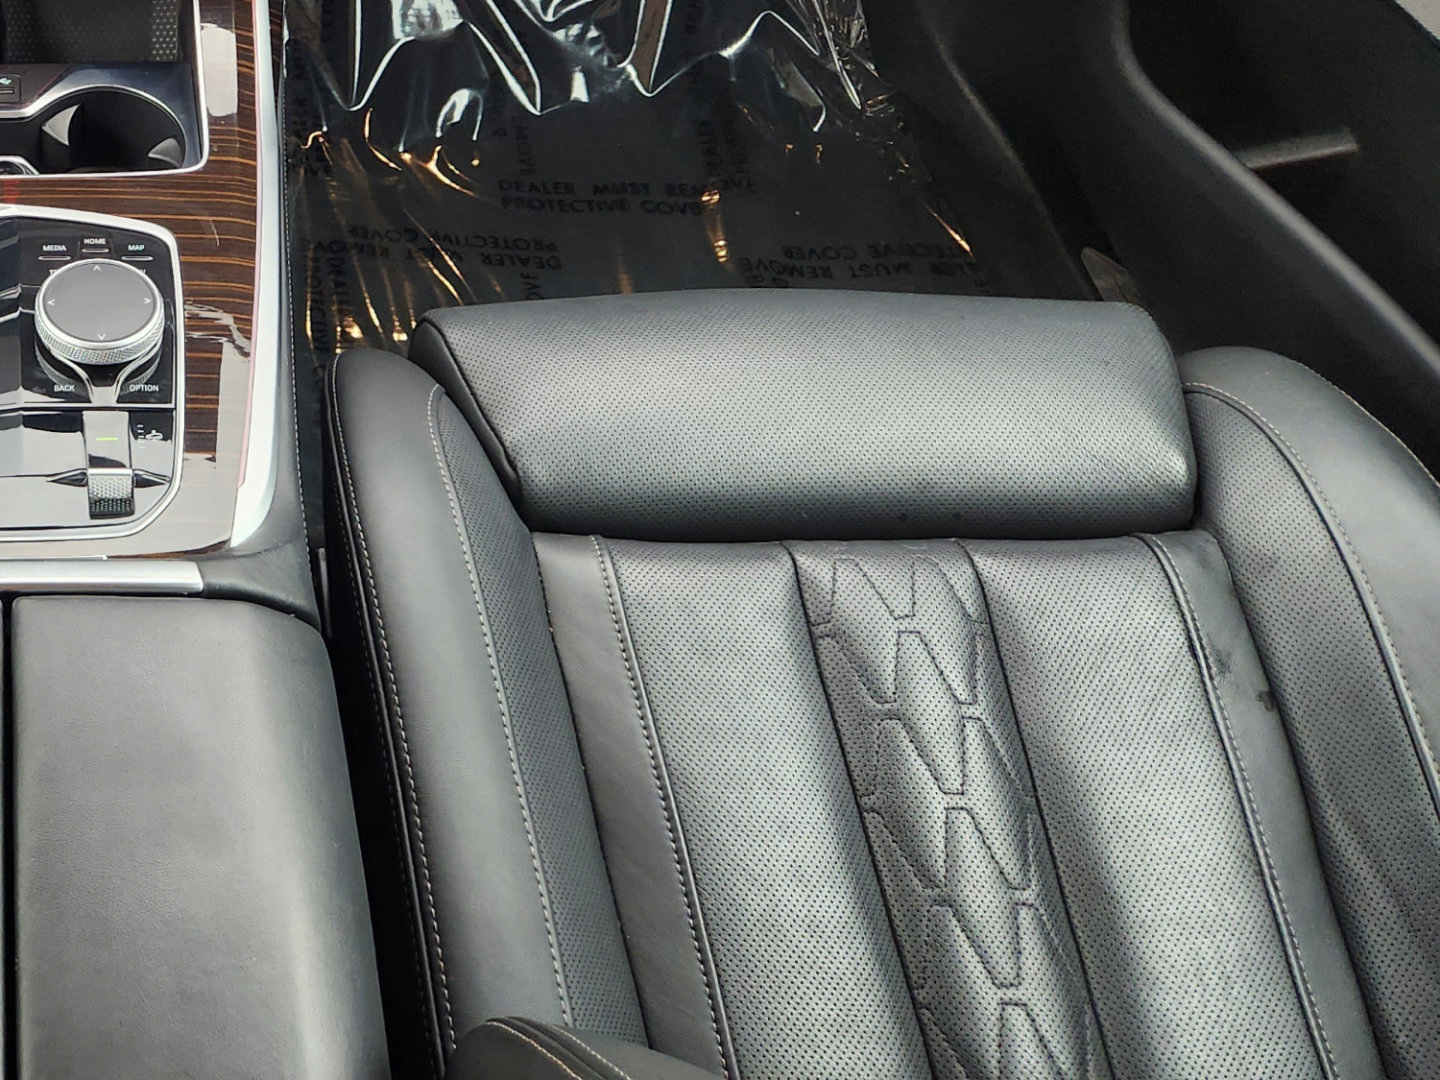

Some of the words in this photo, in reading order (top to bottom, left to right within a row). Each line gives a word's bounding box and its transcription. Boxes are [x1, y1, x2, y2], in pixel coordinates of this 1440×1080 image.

[498, 180, 576, 195] DEALER
[592, 181, 650, 195] MUST
[500, 196, 630, 213] PROTECTIVE
[780, 244, 857, 260] COVER
[480, 252, 562, 270] DEALER
[738, 257, 833, 280] REMOVE
[848, 261, 913, 279] MUST
[53, 384, 76, 392] BACK
[129, 384, 159, 392] OPTION
